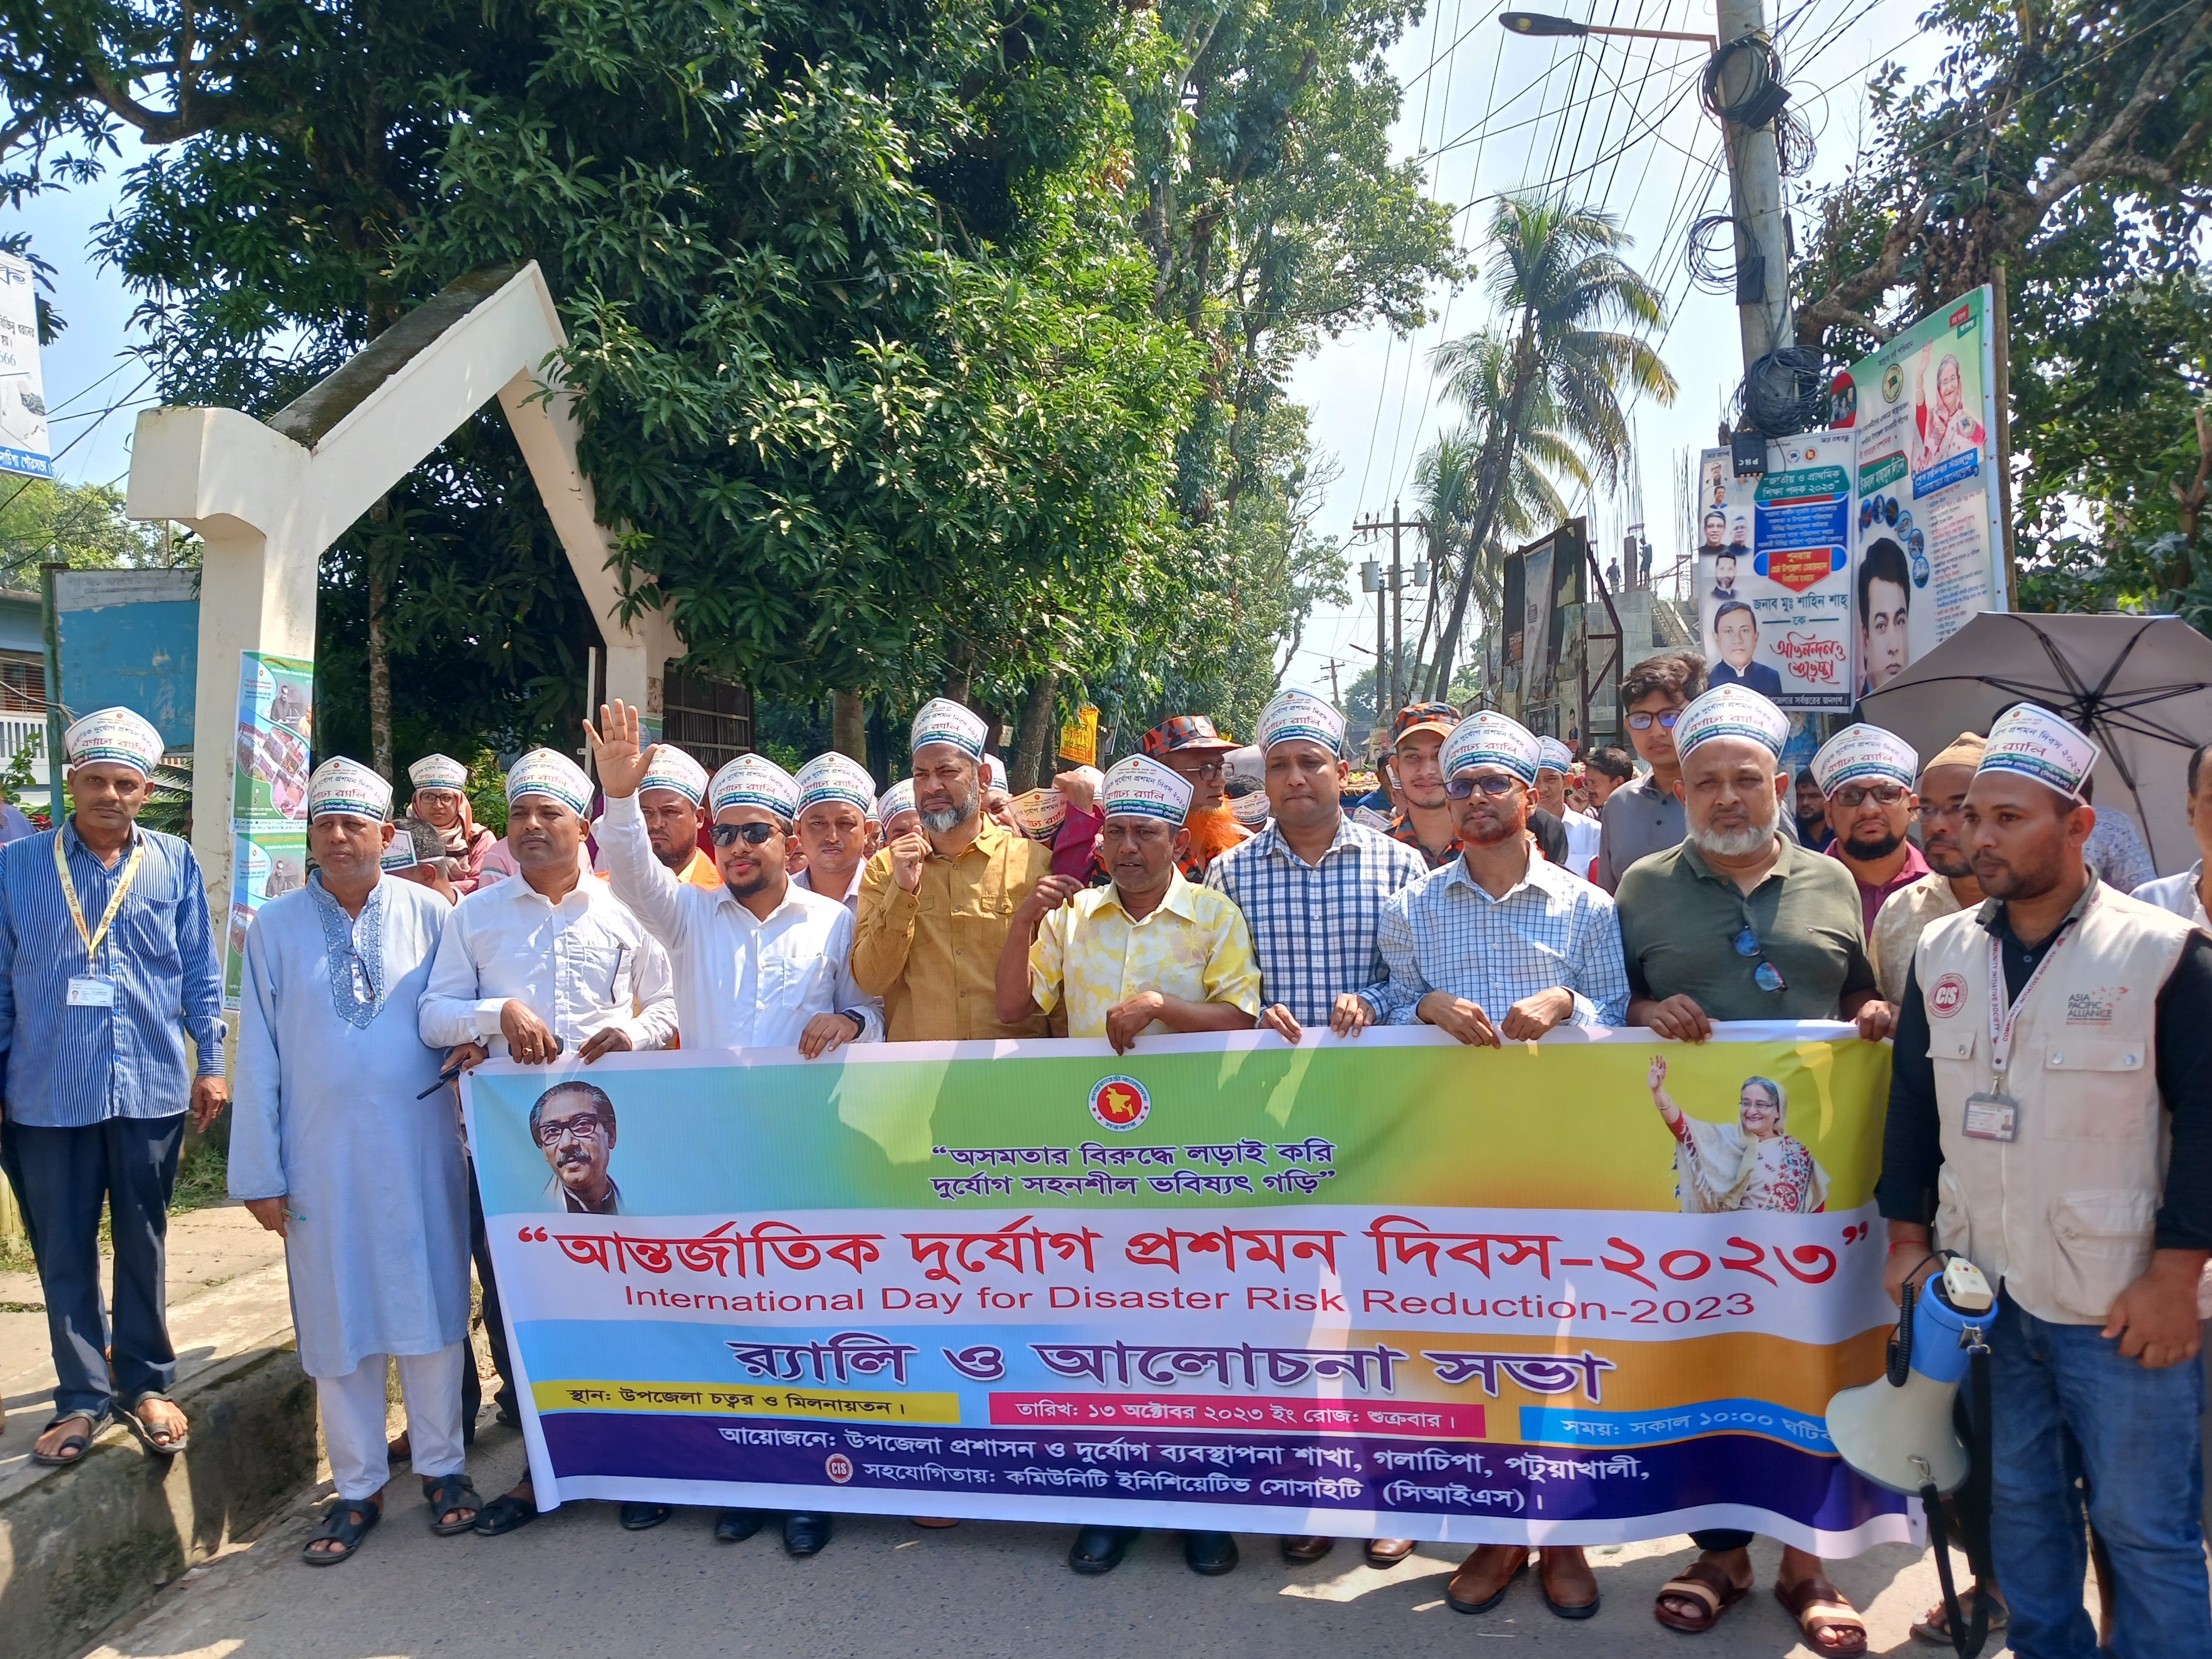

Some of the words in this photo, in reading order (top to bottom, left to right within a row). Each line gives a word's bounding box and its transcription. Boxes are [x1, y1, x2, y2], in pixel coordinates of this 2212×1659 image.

[1752, 598, 1778, 610] জনাব
[1797, 591, 1824, 609] শাহিন
[1792, 616, 1806, 625] কে
[1935, 987, 1958, 1004] CIS
[2002, 1004, 2021, 1042] COMMUNITY
[2018, 975, 2040, 1005] INITIATIVE
[2038, 950, 2056, 975] SOCIETY
[1992, 1003, 2000, 1031] SOCIETY
[1105, 1121, 1136, 1130] সরকার
[1080, 1142, 1176, 1167] বিরুদ্ধে
[1183, 1138, 1267, 1167] লড়াই
[1275, 1138, 1335, 1165] করি
[930, 1171, 1015, 1200] দুর্যোগ
[1023, 1171, 1139, 1196] সহনশীল
[1148, 1171, 1253, 1196] ভবিষ্যৎ
[900, 1215, 1104, 1285] দুর্যোগ
[1125, 1226, 1347, 1275] প্রশমন
[626, 1285, 864, 1312] International
[882, 1287, 963, 1315] Day
[977, 1287, 1033, 1309] for
[1049, 1285, 1230, 1310] Disaster
[1247, 1287, 1346, 1312] Risk
[1362, 1288, 1756, 1324] Reduction-2023
[942, 1345, 1004, 1381] ও
[1030, 1340, 1407, 1390] আলোচনা
[1420, 1349, 1616, 1403] সভা
[618, 1386, 703, 1405] উপজেলা
[710, 1392, 754, 1409] চত্বর
[762, 1396, 777, 1408] ও
[1088, 1403, 1116, 1417] ১৩
[1121, 1400, 1196, 1420] অক্টোবর
[1204, 1406, 1264, 1422] ২০২৩
[1269, 1404, 1297, 1424] ইং
[1629, 1413, 1691, 1434] সকাল
[843, 1428, 942, 1455] উপজেলা
[949, 1438, 1036, 1459] প্রশাসন
[1044, 1442, 1065, 1458] ও
[1072, 1437, 1151, 1465] দুর্যোগ
[1159, 1444, 1285, 1469] ব্যবস্থাপনা
[831, 1462, 847, 1475] CIS
[1004, 1468, 1110, 1489] কমিউনিটি
[1115, 1470, 1251, 1493] ইনিশিয়েটিভ
[1259, 1476, 1364, 1501] সোসাইটি
[1382, 1480, 1526, 1512] (সিআইএস)
